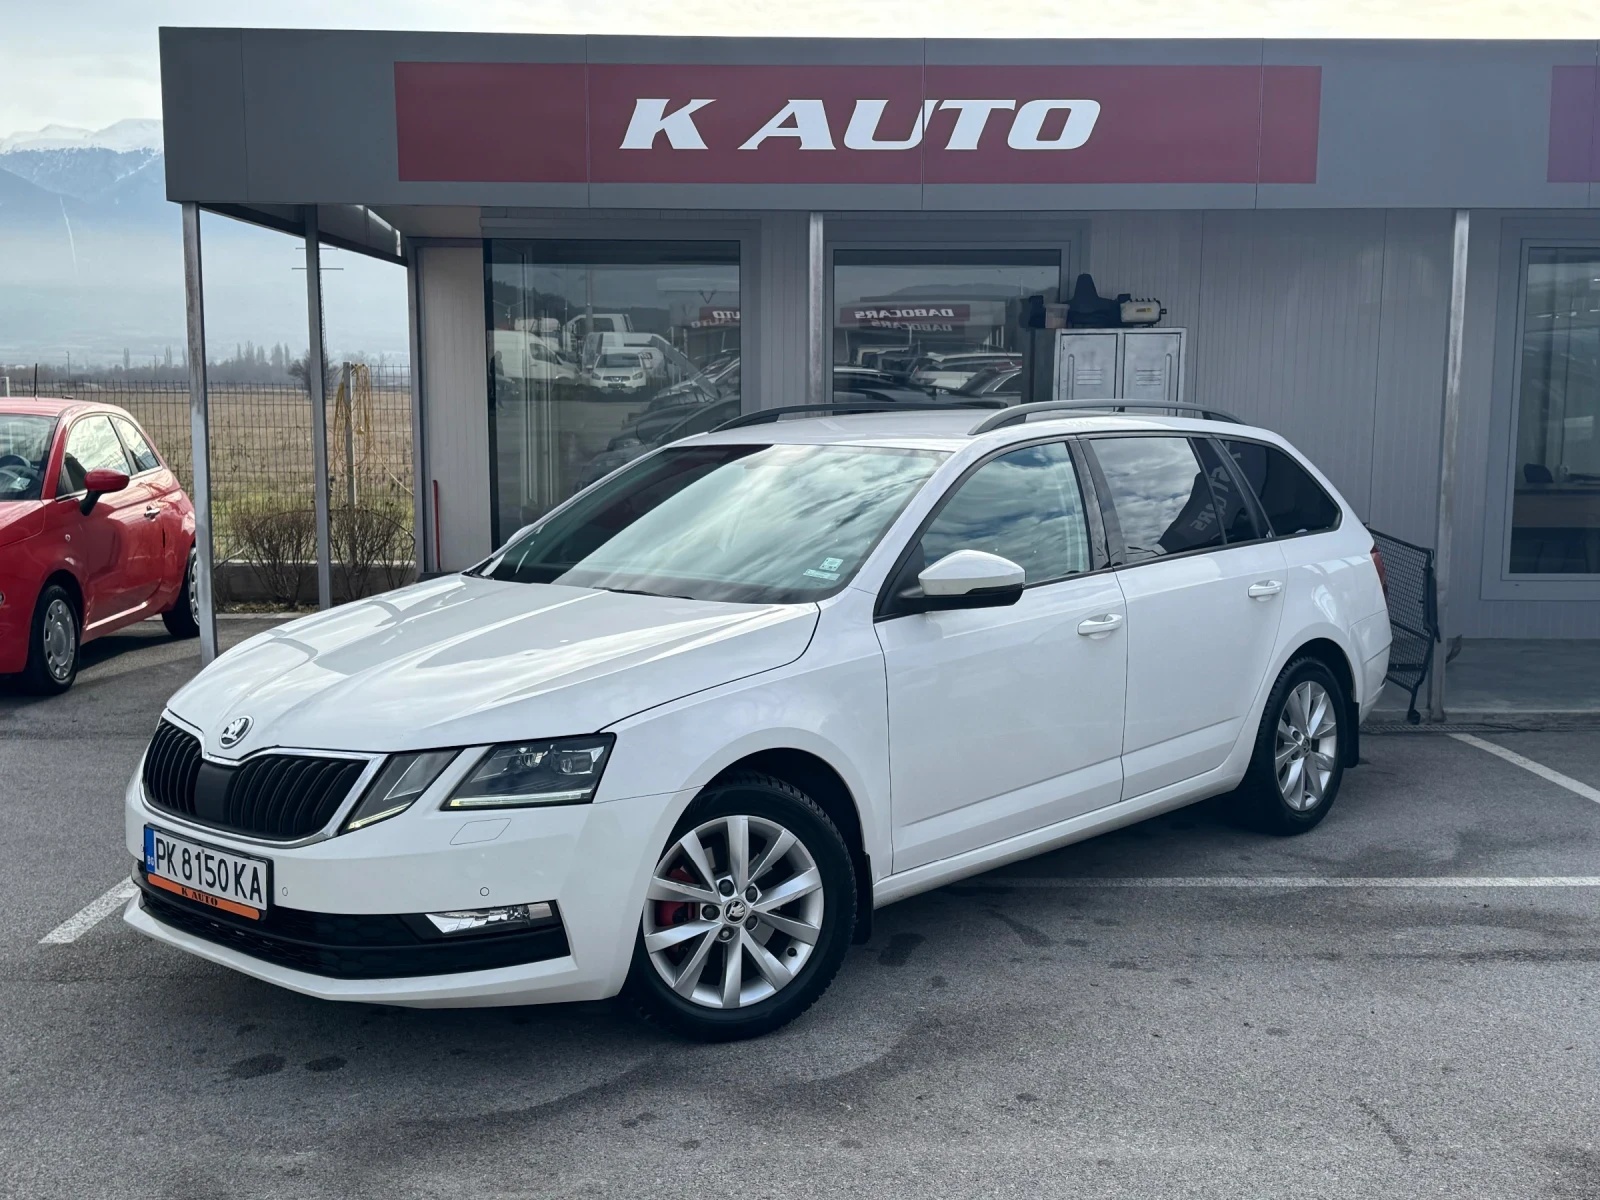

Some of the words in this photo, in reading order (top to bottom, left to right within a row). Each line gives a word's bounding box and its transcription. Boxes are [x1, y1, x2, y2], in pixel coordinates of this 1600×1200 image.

[619, 98, 717, 150] K
[737, 98, 1101, 151] AUTO
[155, 837, 178, 877] PK
[181, 847, 229, 893] 8150
[234, 861, 263, 904] KA
[181, 887, 188, 896] K
[192, 891, 218, 906] AUTO
